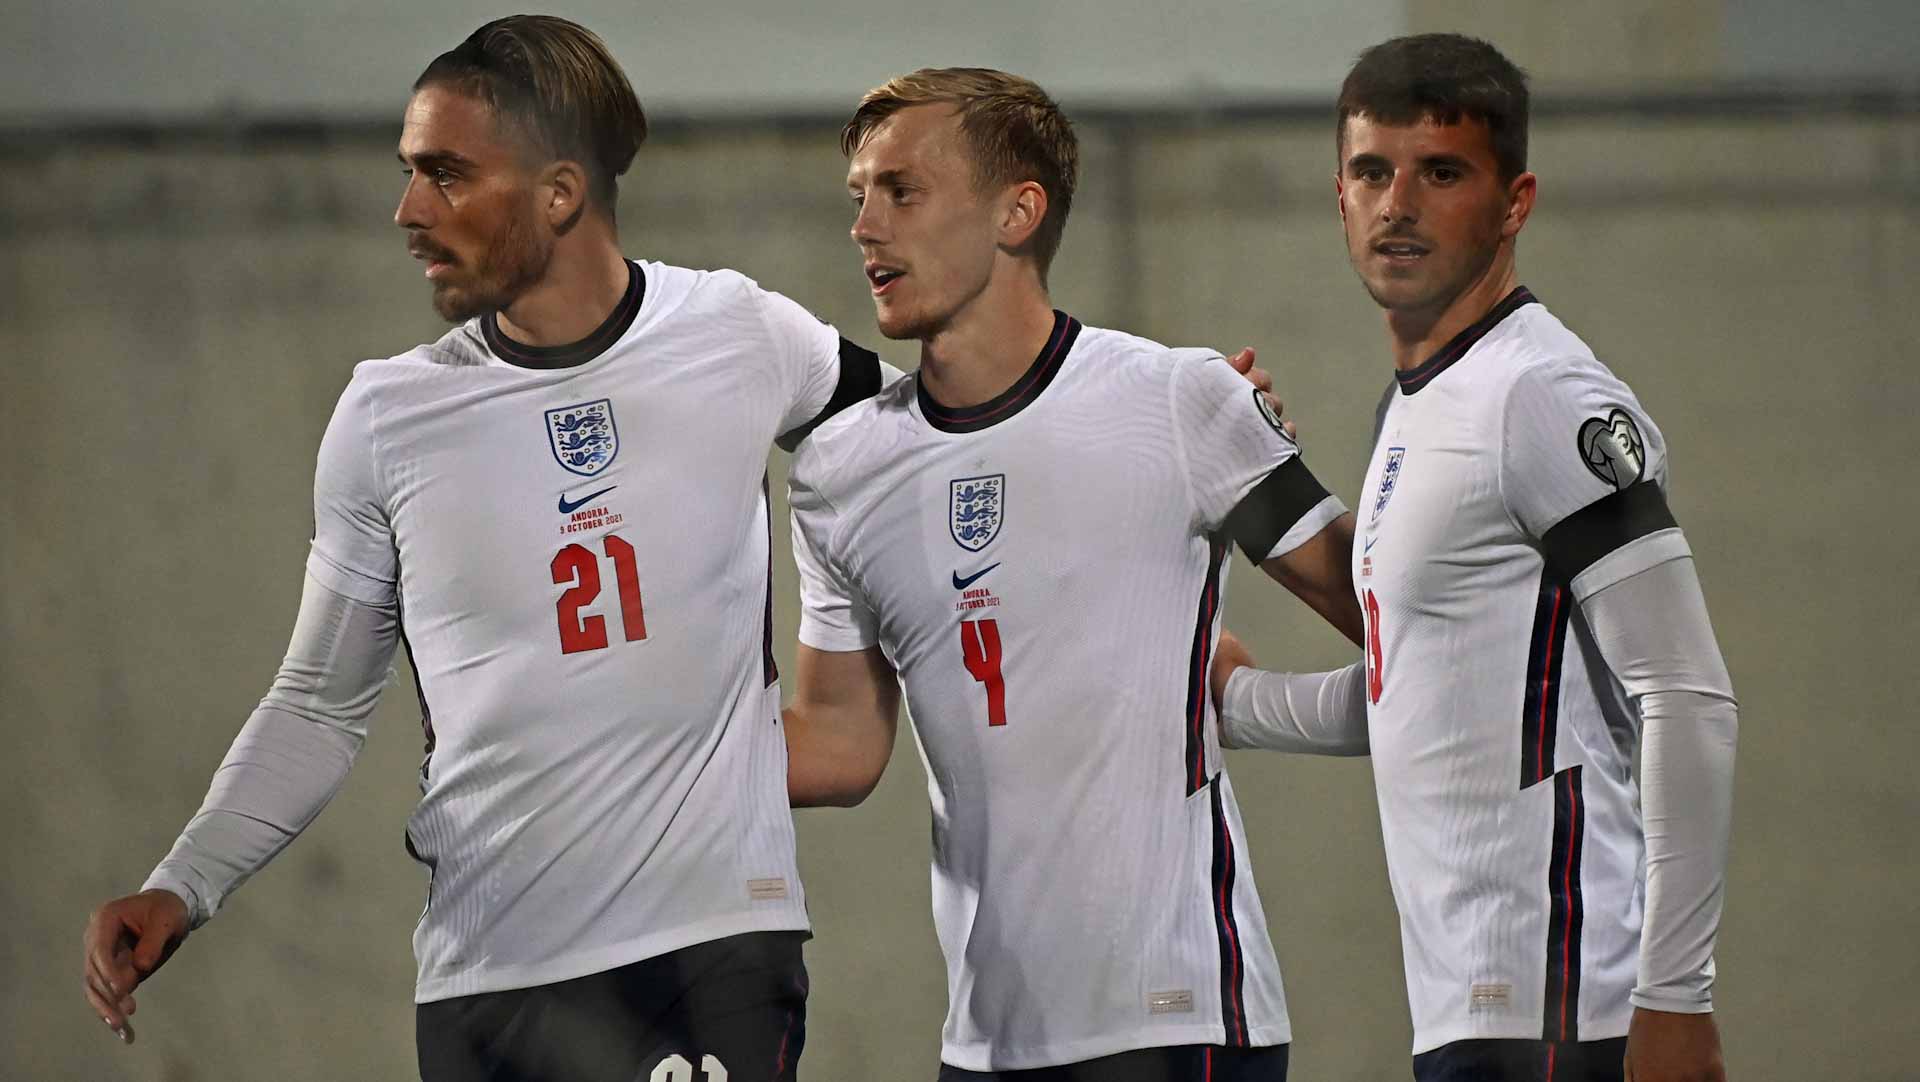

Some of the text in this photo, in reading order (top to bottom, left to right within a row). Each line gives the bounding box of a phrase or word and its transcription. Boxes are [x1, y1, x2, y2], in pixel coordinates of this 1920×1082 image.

[567, 518, 604, 533] OCTOBER
[605, 513, 623, 525] 2021
[571, 506, 609, 522] ANDORRA
[550, 534, 647, 655] 21
[960, 618, 1008, 727] 4
